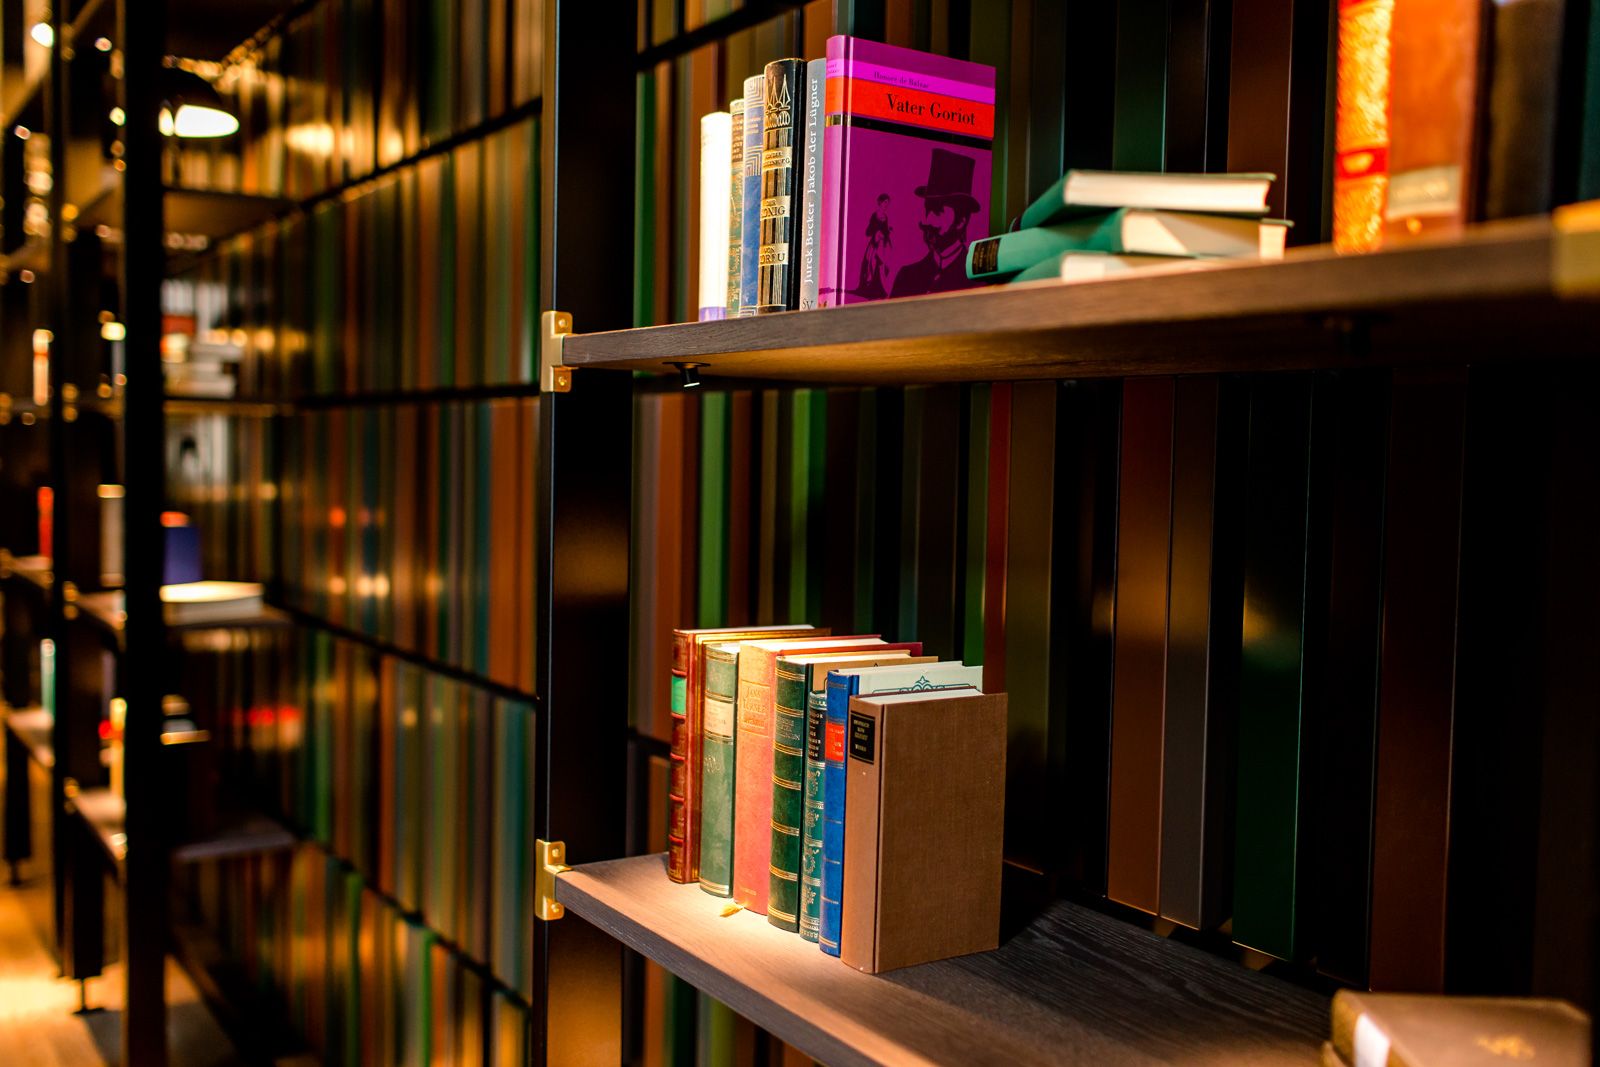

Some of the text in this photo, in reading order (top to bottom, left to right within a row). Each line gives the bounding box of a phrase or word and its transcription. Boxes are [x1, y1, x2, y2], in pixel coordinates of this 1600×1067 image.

[886, 93, 977, 126] Vater Goriot
[804, 78, 820, 284] Jurek Becker Jakob der Lügner
